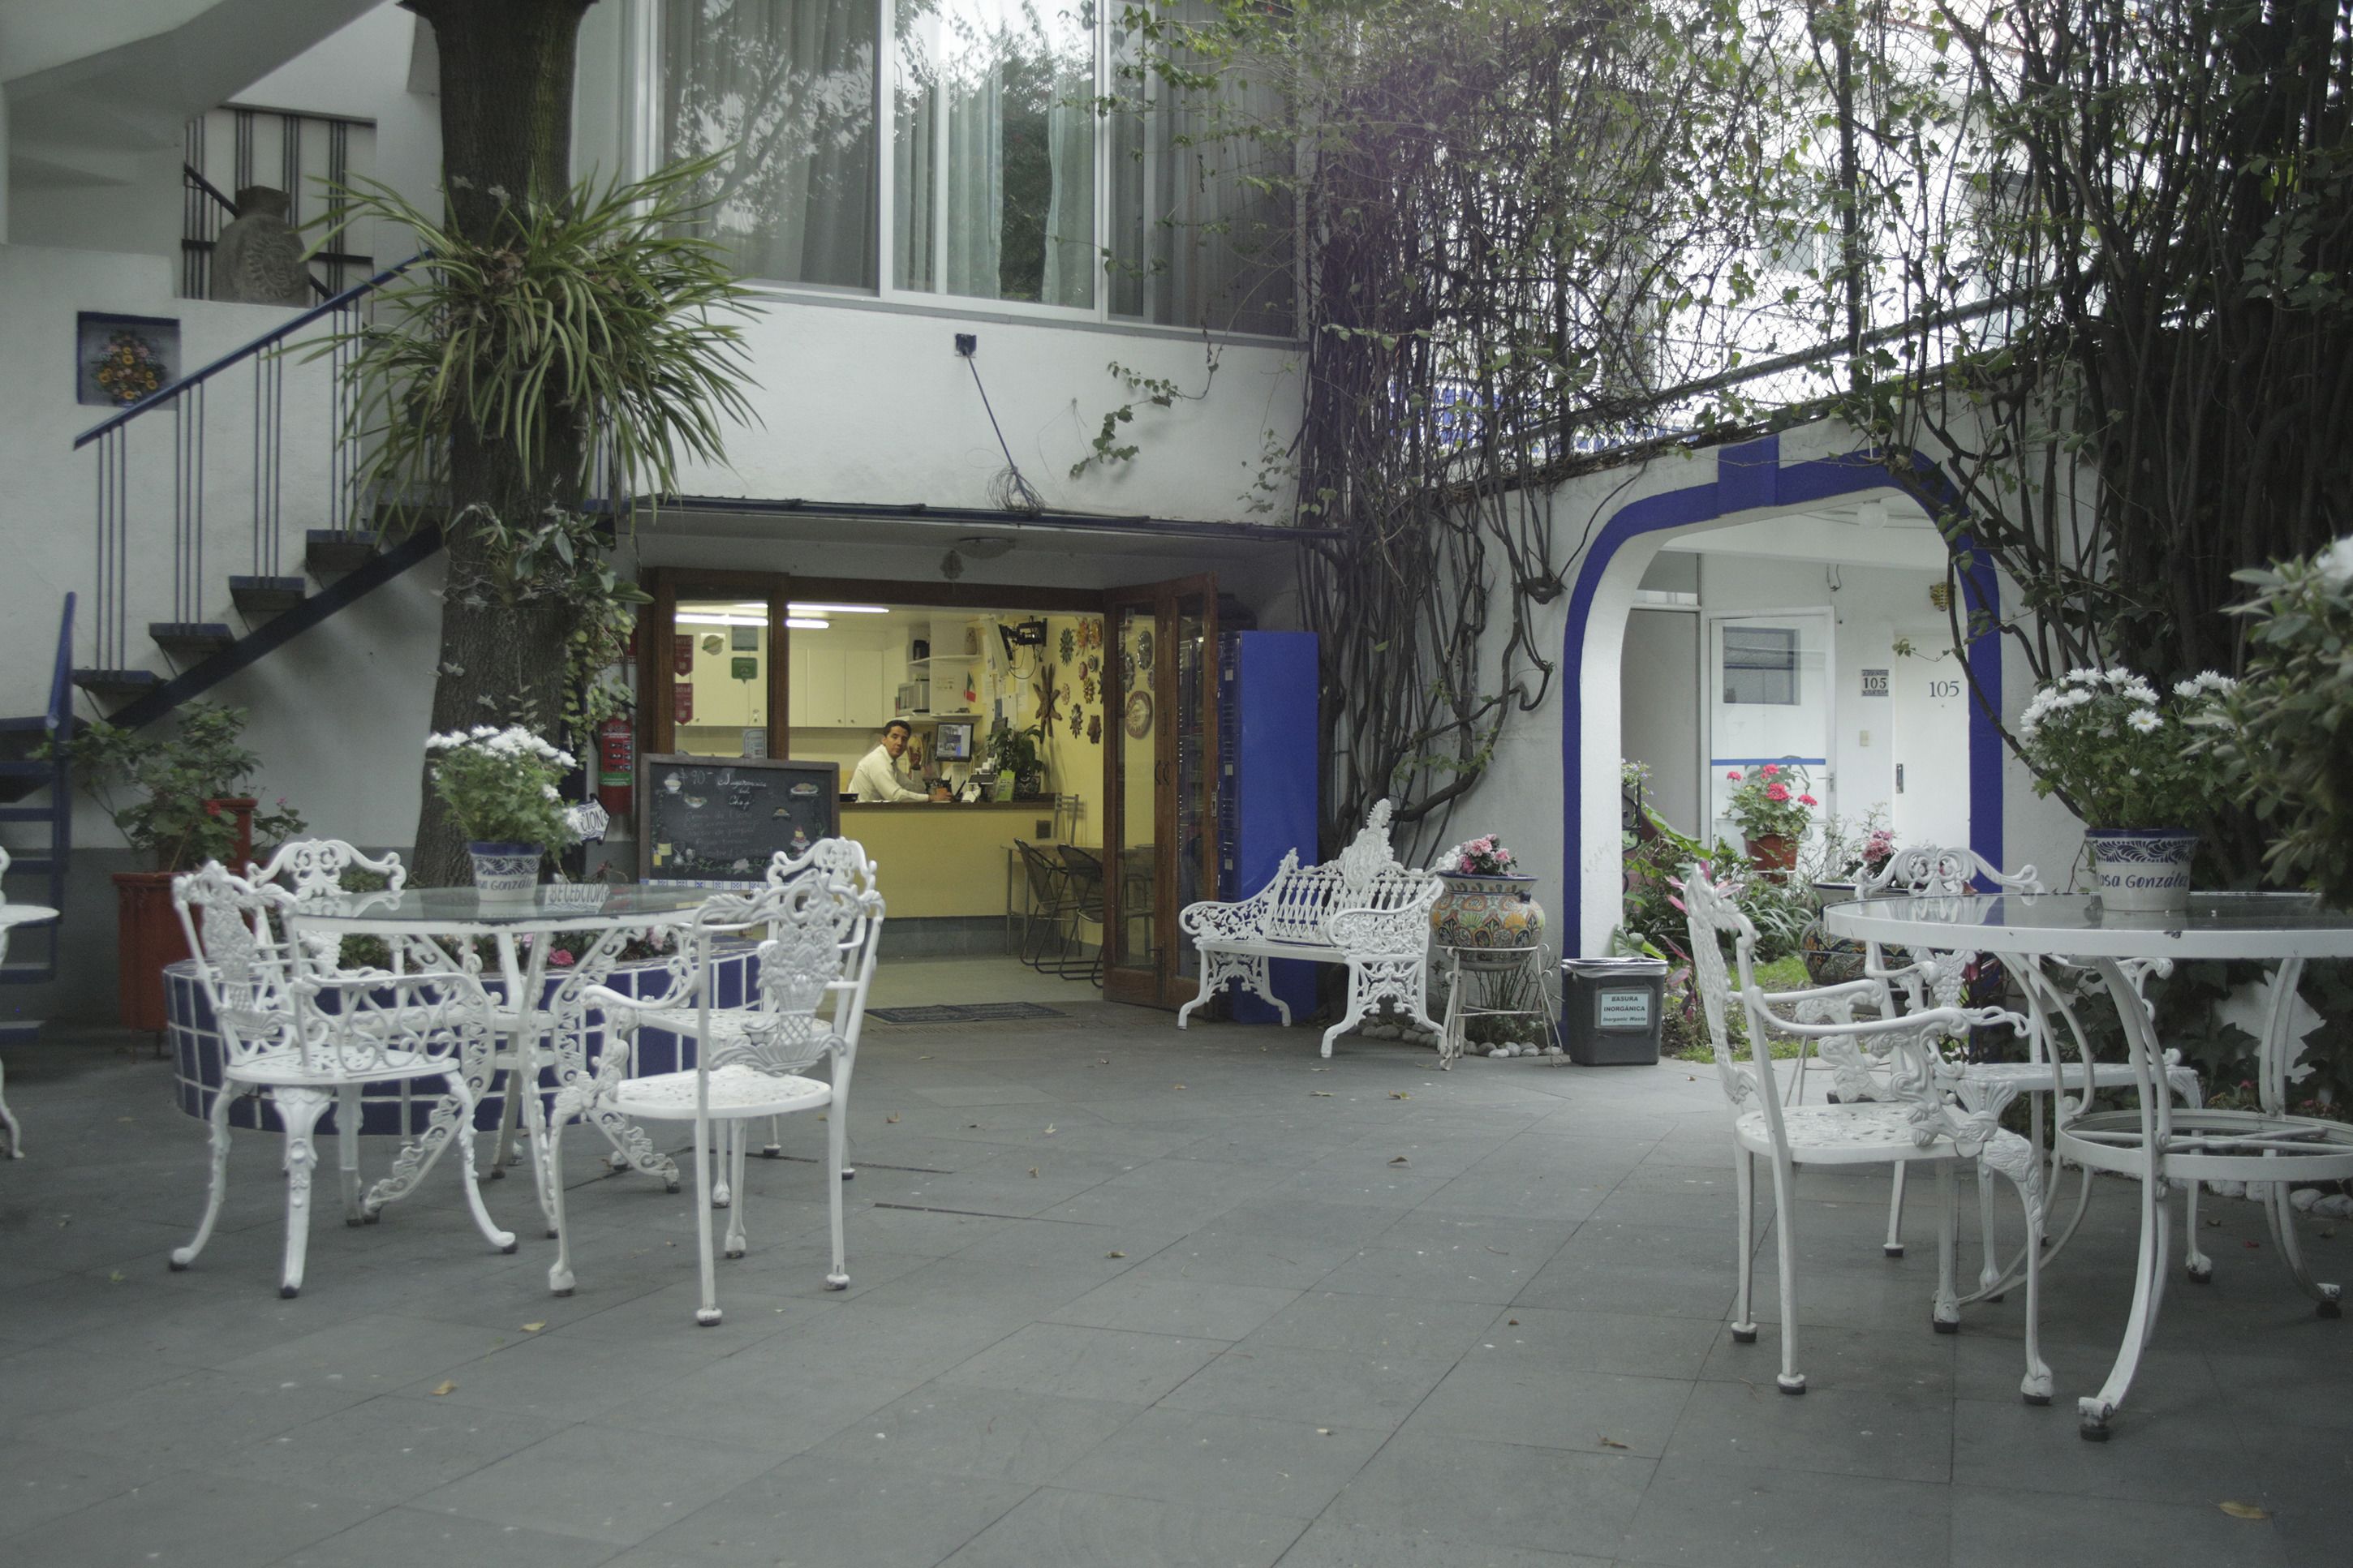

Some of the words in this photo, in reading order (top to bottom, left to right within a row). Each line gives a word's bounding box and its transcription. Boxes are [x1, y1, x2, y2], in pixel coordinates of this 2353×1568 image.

[1863, 677, 1887, 689] 105
[1929, 681, 1960, 698] 105
[2097, 874, 2120, 887] osa
